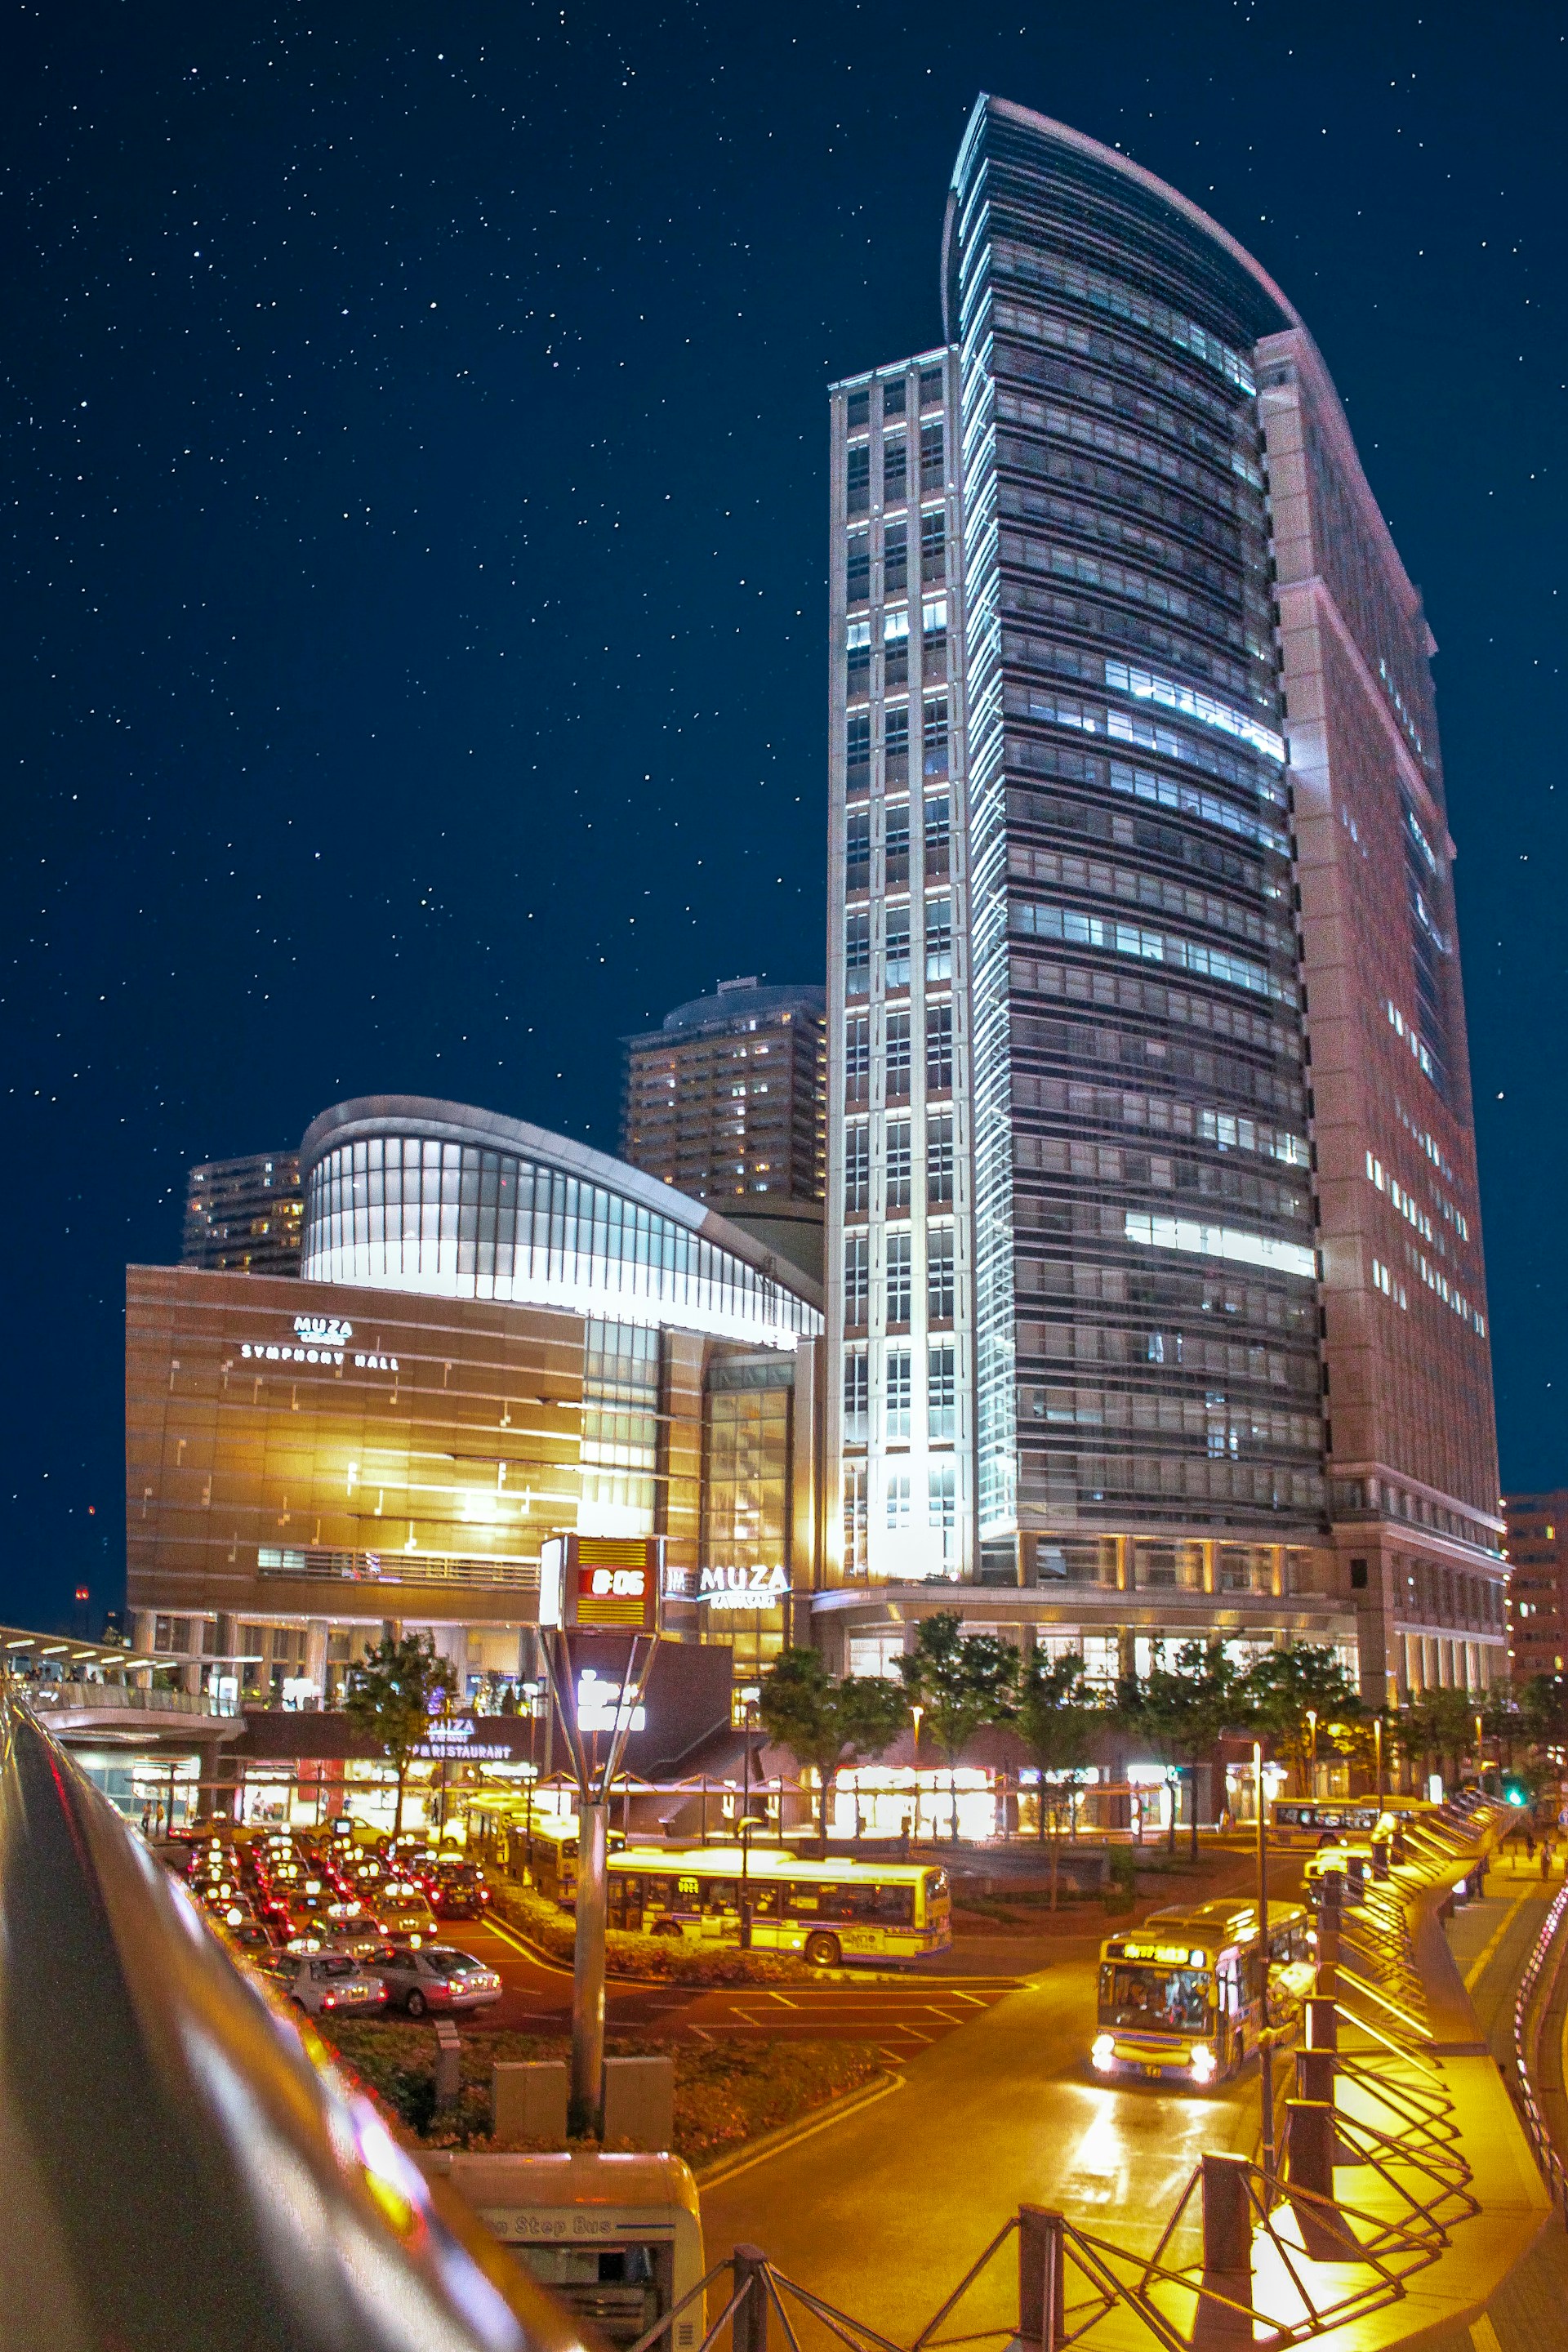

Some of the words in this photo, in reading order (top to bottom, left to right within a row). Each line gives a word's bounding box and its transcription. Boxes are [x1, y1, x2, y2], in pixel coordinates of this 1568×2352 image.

[294, 1316, 353, 1336] MUZA
[241, 1344, 344, 1365] SYMPHONY
[354, 1355, 398, 1371] HALL
[700, 1565, 790, 1591] MUZA
[515, 2216, 565, 2237] Step
[572, 2216, 611, 2234] Bus
